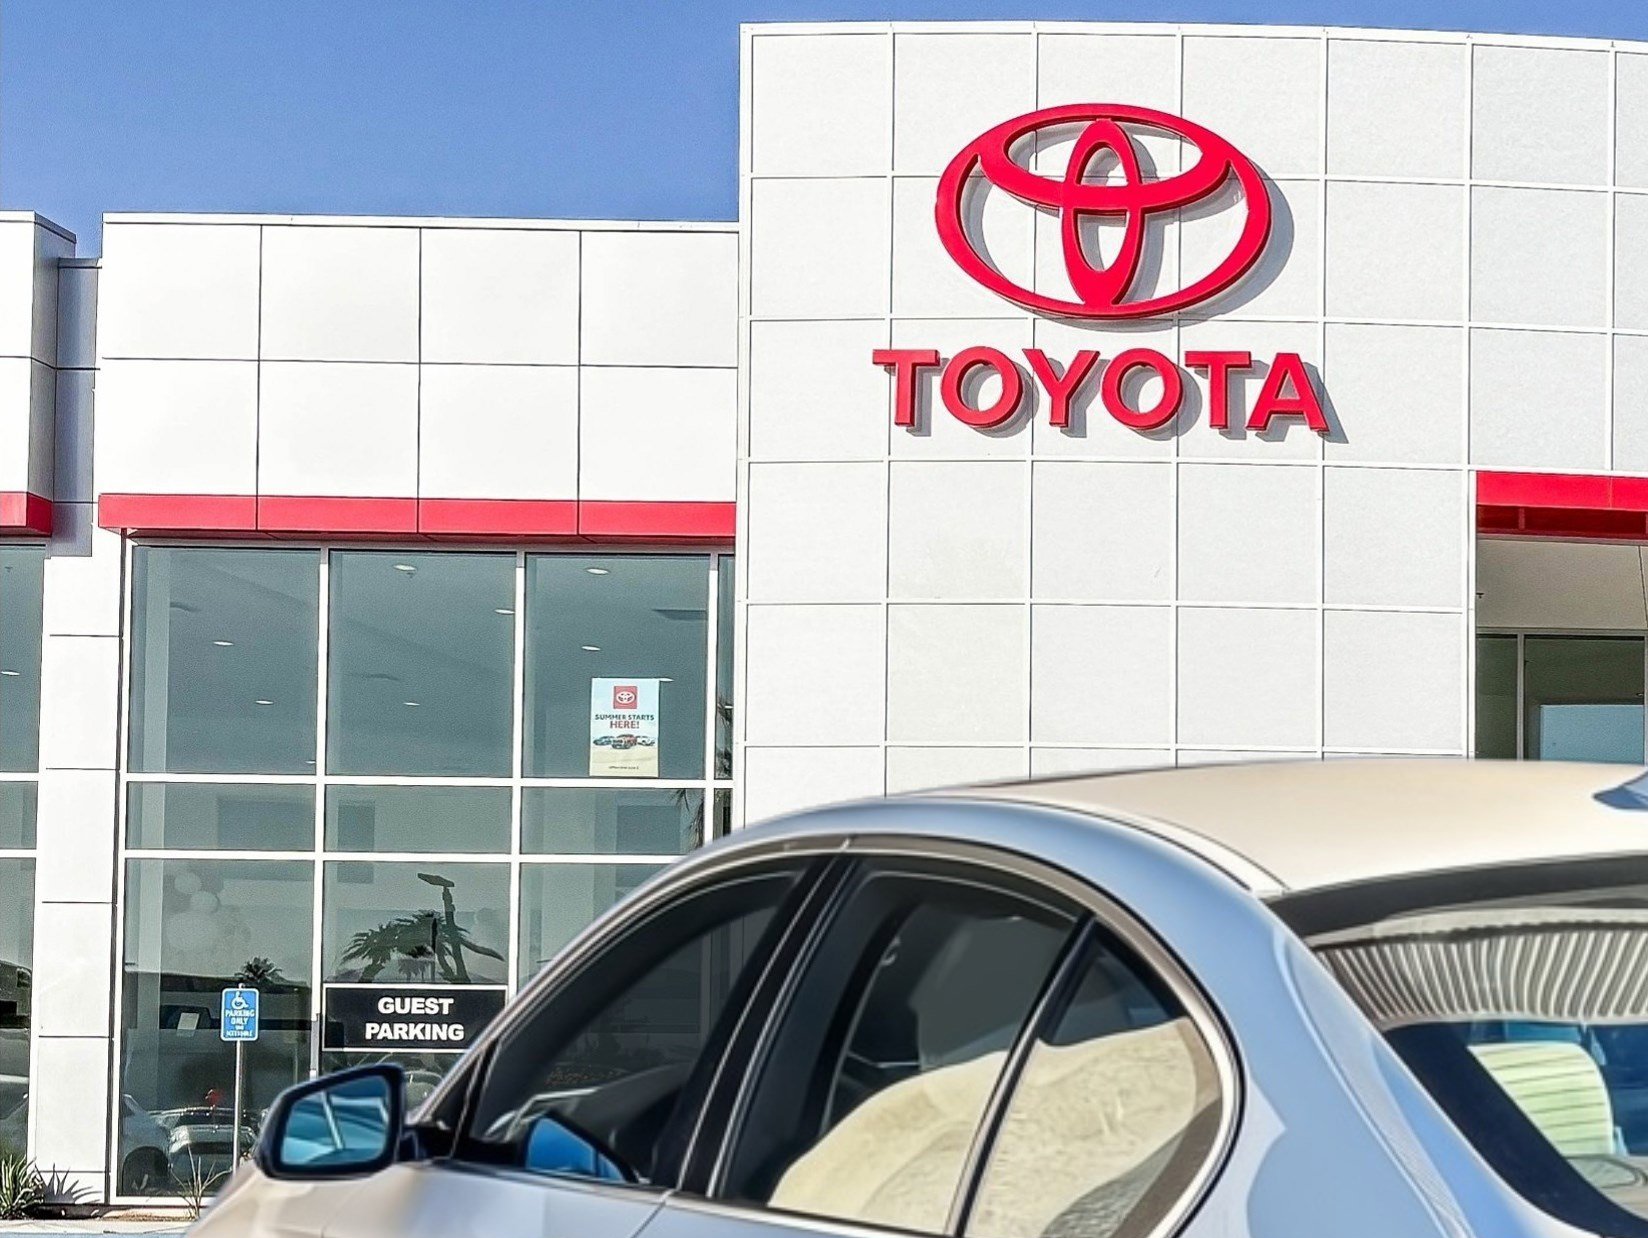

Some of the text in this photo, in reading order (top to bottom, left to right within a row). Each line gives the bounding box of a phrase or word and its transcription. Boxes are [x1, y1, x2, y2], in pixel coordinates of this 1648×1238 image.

[872, 345, 1330, 433] TOYOTA
[609, 720, 640, 729] HERE!
[377, 996, 455, 1015] GUEST
[364, 1022, 465, 1042] PARKING
